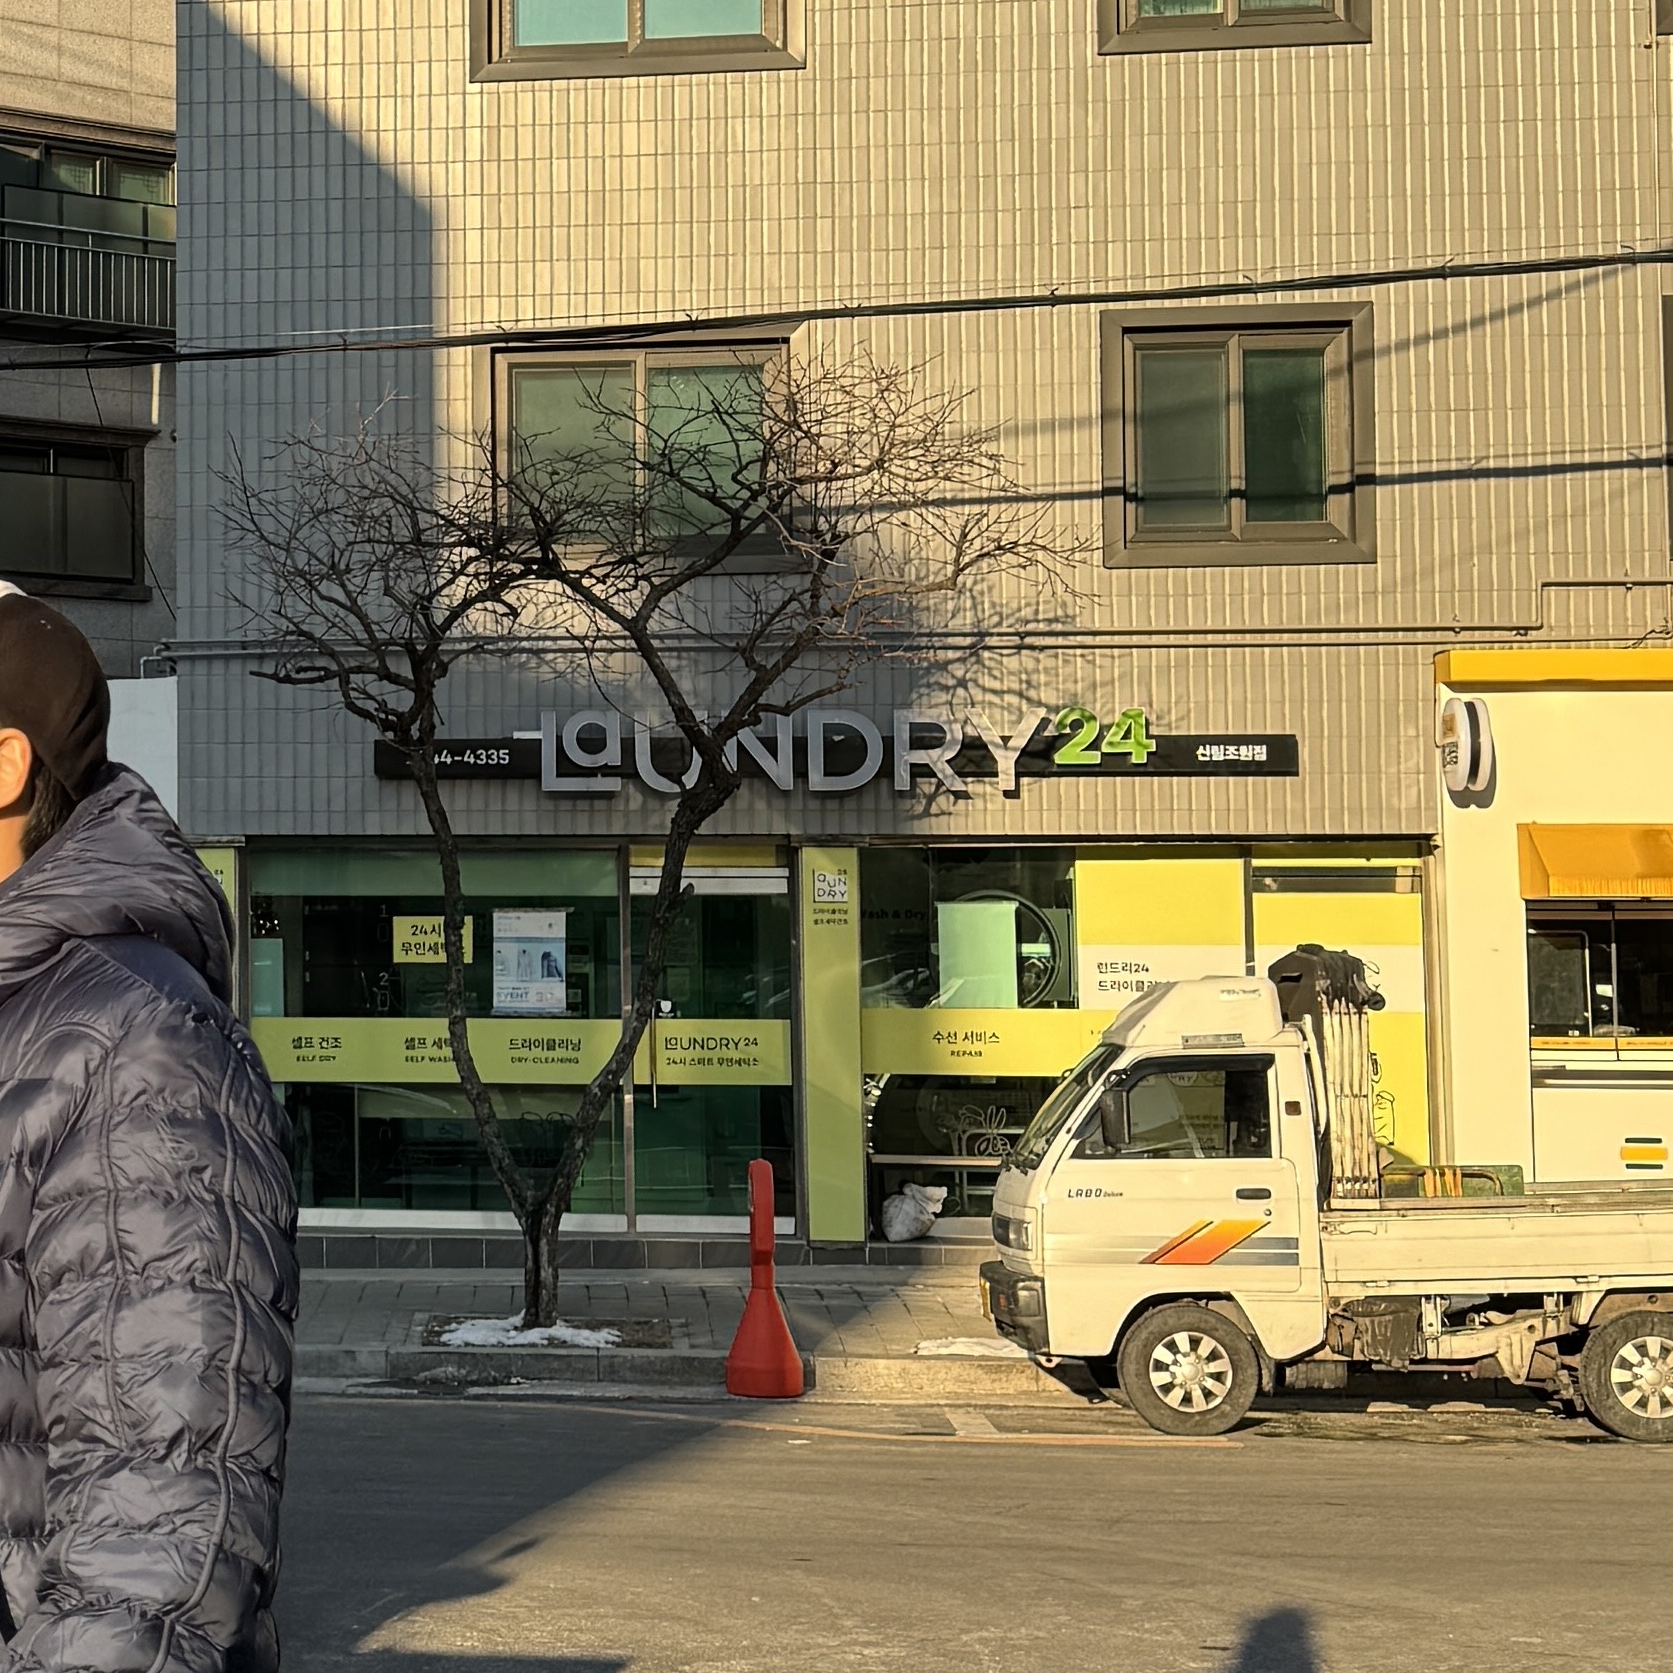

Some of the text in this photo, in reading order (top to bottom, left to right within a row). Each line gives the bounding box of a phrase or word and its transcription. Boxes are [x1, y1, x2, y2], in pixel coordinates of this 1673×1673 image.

[410, 921, 441, 938] 24시
[318, 1036, 342, 1050] 건조
[404, 1037, 428, 1051] 셀프
[508, 1037, 582, 1052] 드라이클리닝
[931, 1030, 1001, 1046] 수선 서비스
